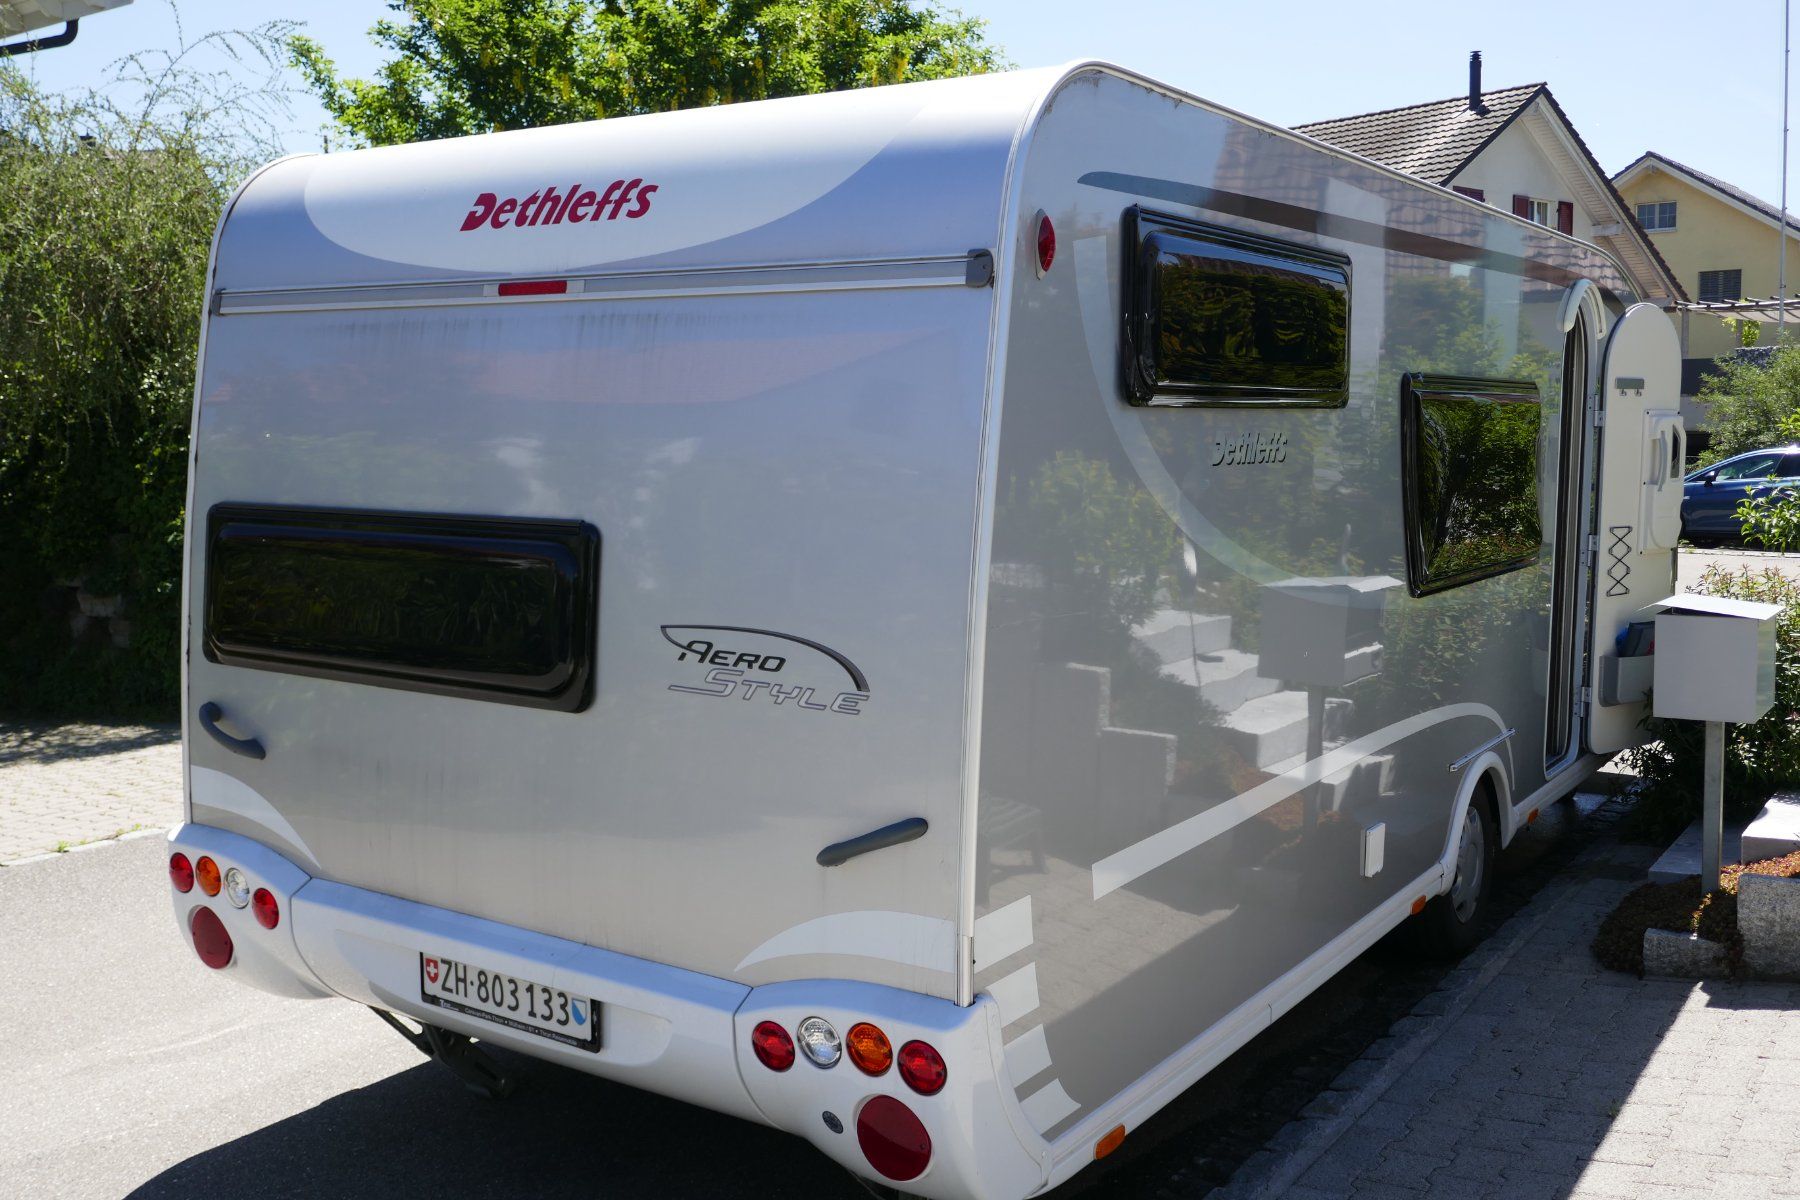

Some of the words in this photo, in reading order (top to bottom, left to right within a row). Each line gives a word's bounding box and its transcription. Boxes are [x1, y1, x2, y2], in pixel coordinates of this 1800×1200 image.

[460, 178, 659, 231] Dethleffs
[1211, 432, 1288, 467] Dethleffs
[678, 640, 786, 672] AERO
[668, 668, 869, 715] STYLE
